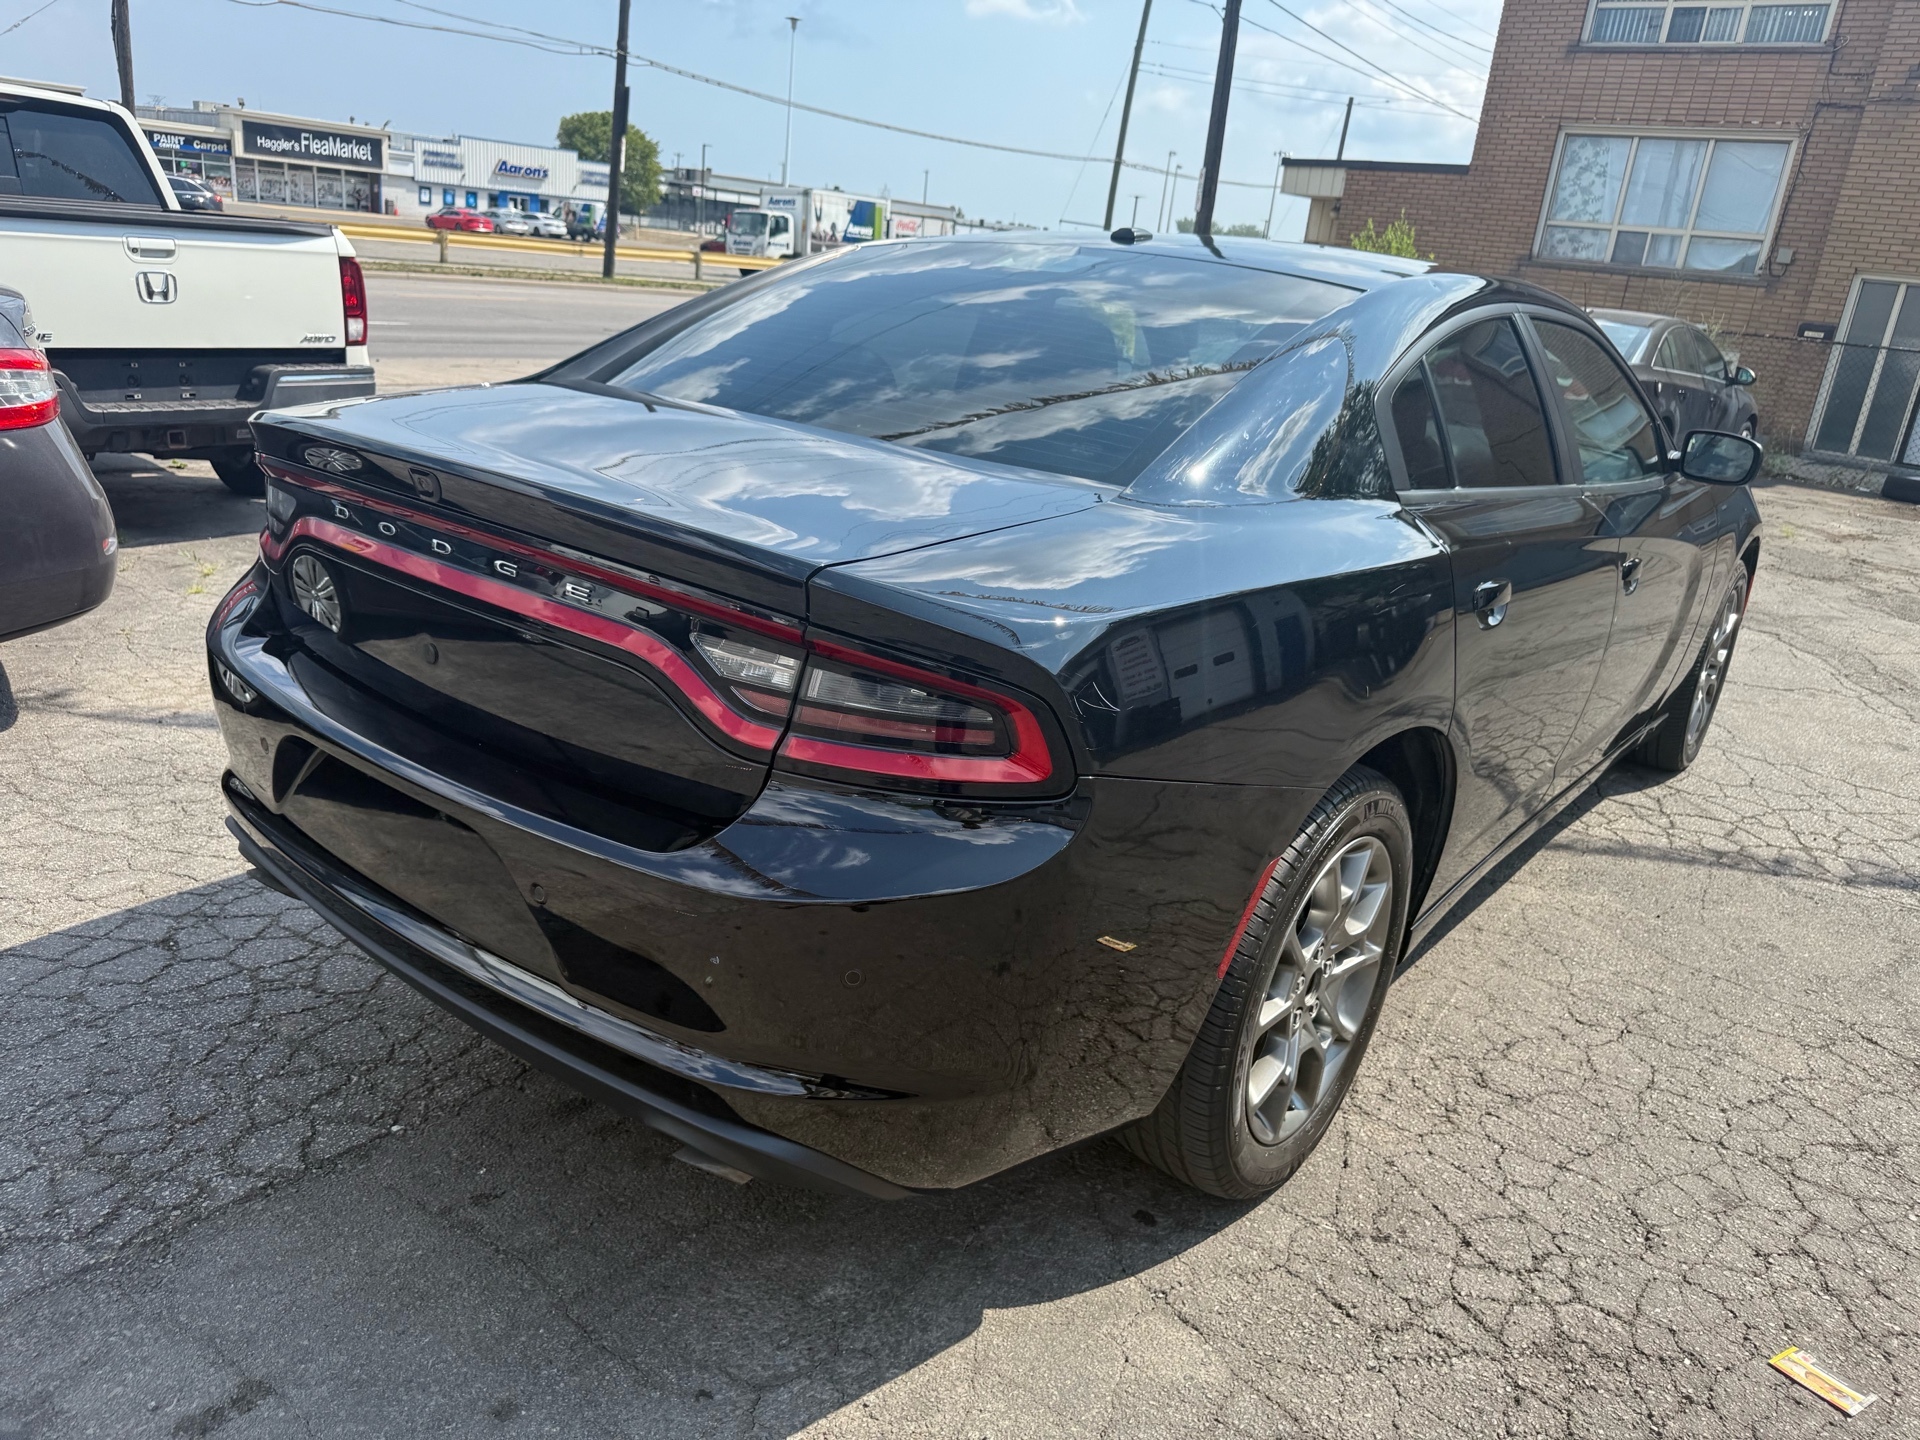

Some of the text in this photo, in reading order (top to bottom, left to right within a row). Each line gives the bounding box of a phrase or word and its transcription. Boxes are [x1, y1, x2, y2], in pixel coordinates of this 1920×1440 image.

[153, 133, 185, 146] PAINT
[158, 142, 180, 150] CENTER
[193, 140, 228, 152] Carpet
[257, 132, 372, 161] Haggler's FleaMarket
[299, 332, 337, 344] AWD
[333, 504, 593, 604] DODGE
